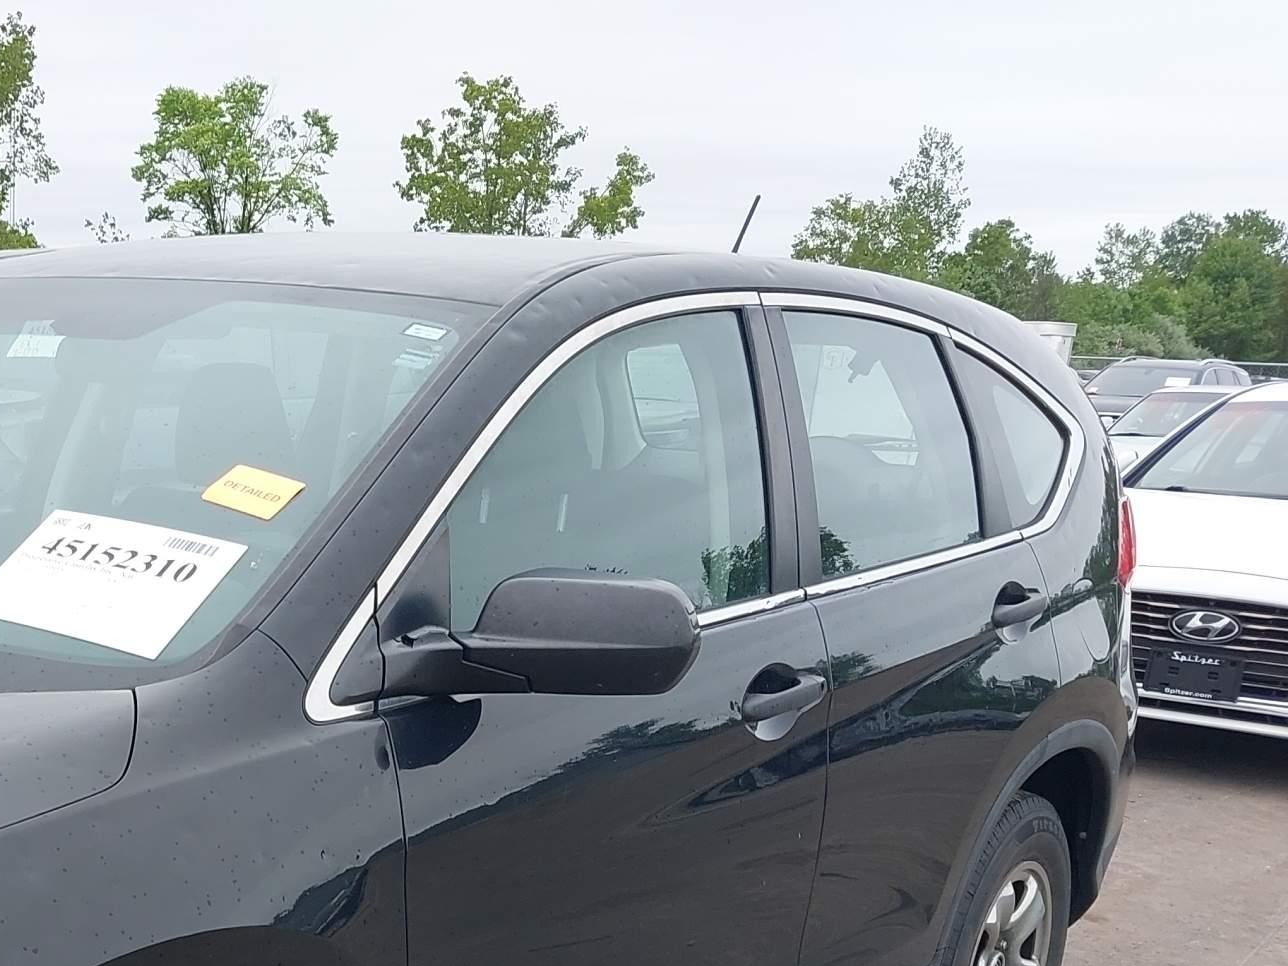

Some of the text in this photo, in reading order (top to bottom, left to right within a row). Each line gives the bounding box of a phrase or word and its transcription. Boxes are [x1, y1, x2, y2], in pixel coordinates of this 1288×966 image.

[223, 480, 281, 502] DETAILED
[41, 536, 198, 584] 45152310
[1170, 650, 1221, 666] Spitzer
[1164, 687, 1213, 699] Spitzer.com
